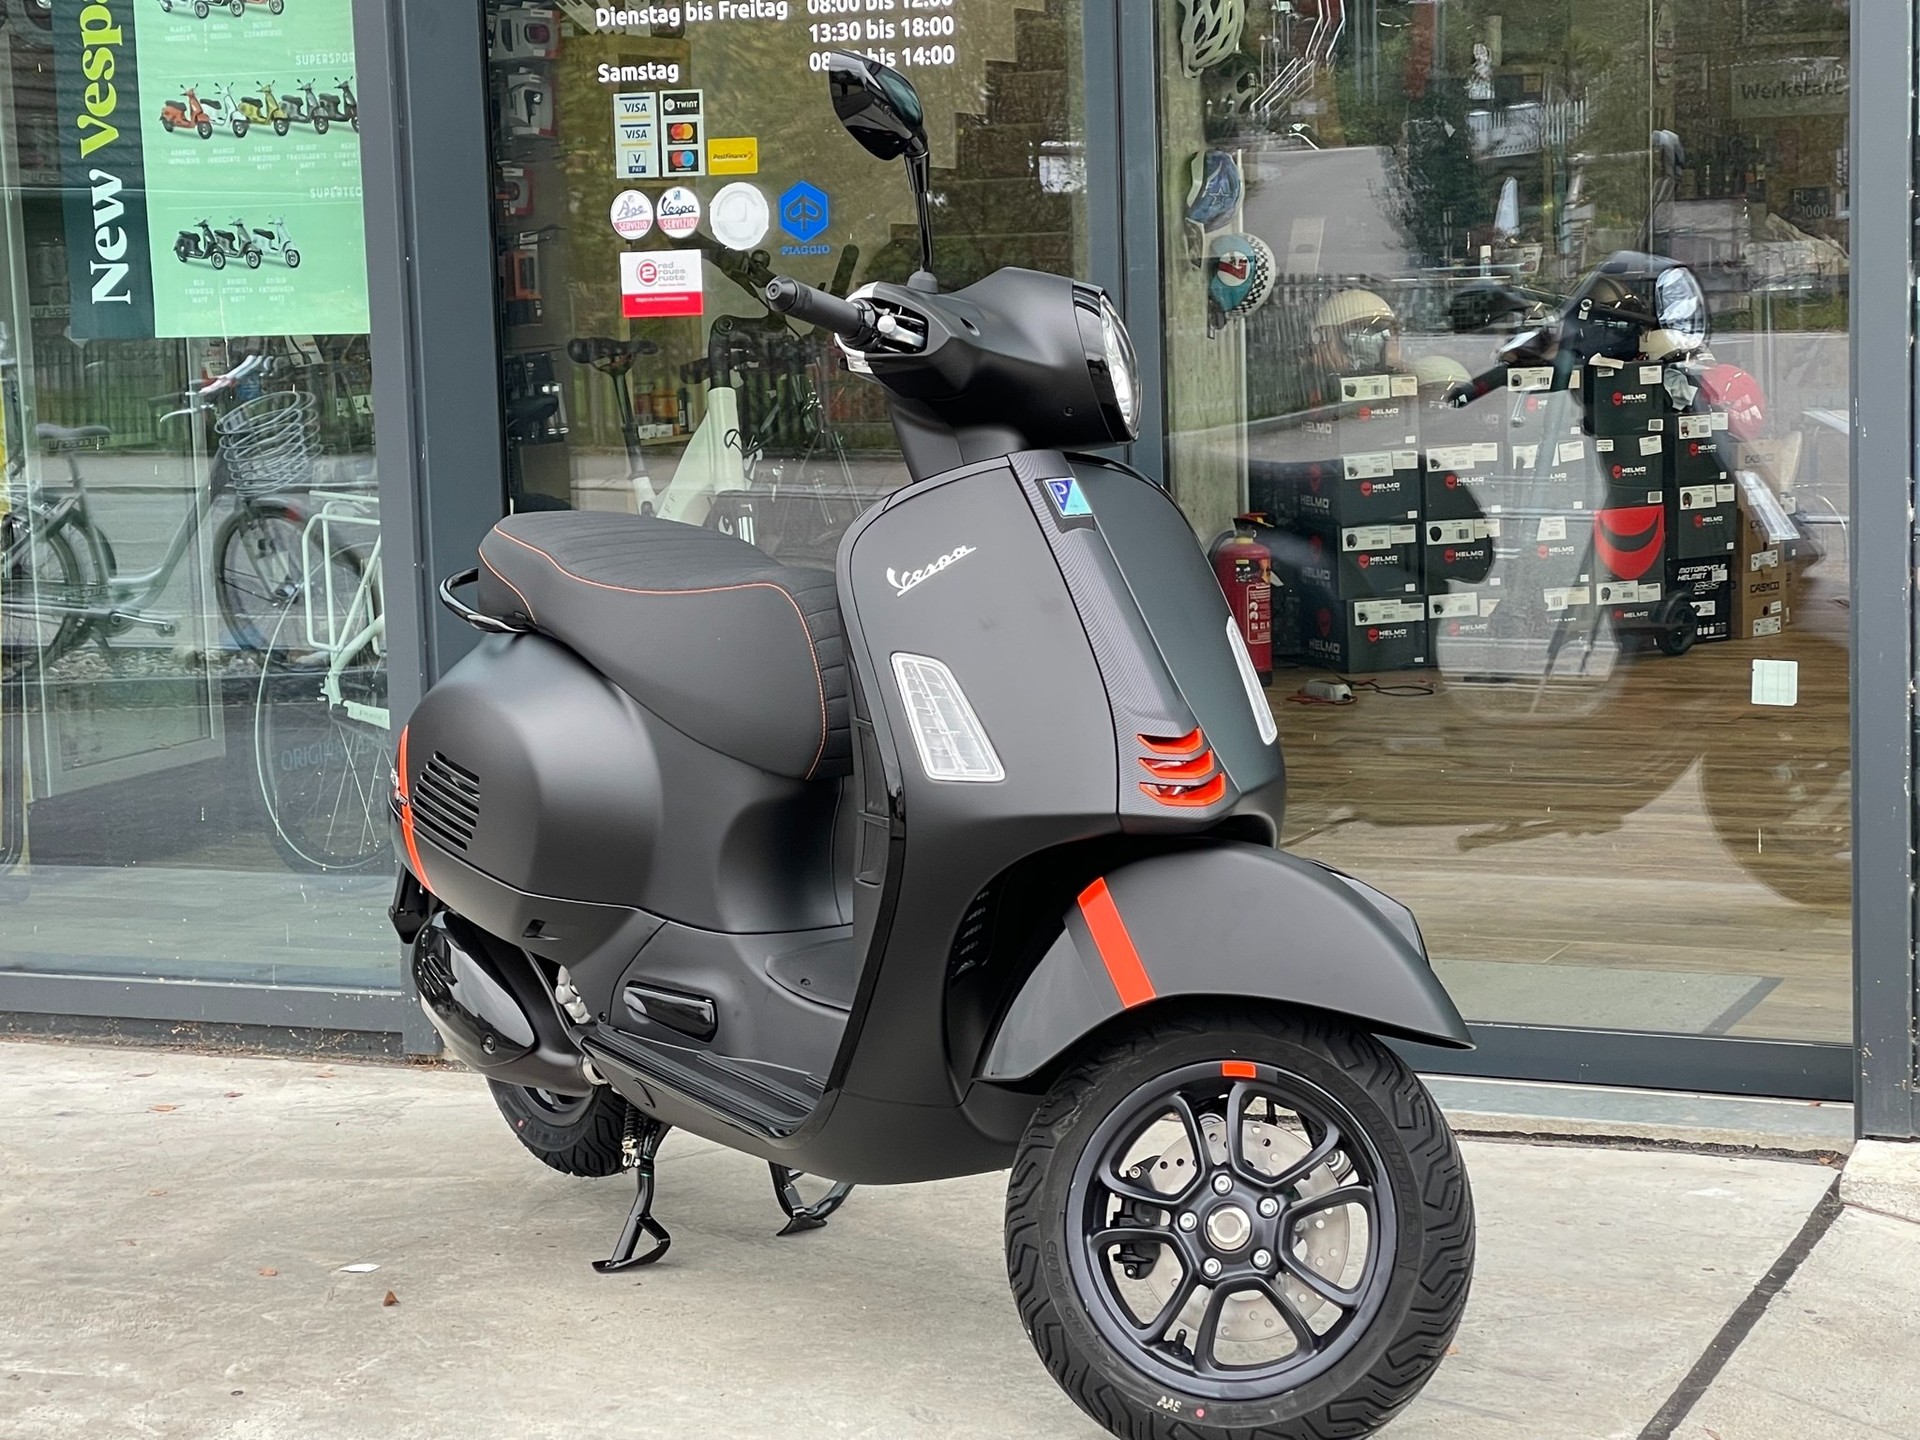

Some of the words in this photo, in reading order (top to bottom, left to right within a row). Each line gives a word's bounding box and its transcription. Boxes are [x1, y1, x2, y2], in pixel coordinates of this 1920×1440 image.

[596, 6, 681, 27] Dienstag
[685, 1, 713, 21] bis
[718, 0, 788, 20] Freitag
[808, 21, 861, 43] 13:30
[866, 19, 895, 40] bis
[901, 16, 954, 38] 18:00
[901, 44, 955, 66] 14:00
[598, 62, 679, 83] Samstag
[77, 0, 123, 159] Vesp
[625, 103, 647, 113] VISA
[626, 129, 647, 139] VISA
[633, 153, 641, 164] V
[712, 152, 748, 160] PostFinance
[661, 196, 697, 217] Vespa
[618, 221, 648, 231] SERVIZIO
[663, 218, 697, 230] SERVIZIO
[89, 168, 131, 305] New
[781, 245, 830, 256] PIAGGIO
[657, 261, 674, 269] rad
[1370, 407, 1399, 415] HELMO
[1456, 476, 1484, 484] HELMO
[1372, 482, 1400, 490] HELMO
[1300, 494, 1330, 509] HELMO
[886, 545, 977, 597] Vespa
[1678, 563, 1727, 574] MOTORCYCLE
[1677, 572, 1707, 581] HELMET
[1623, 610, 1649, 618] HELMO
